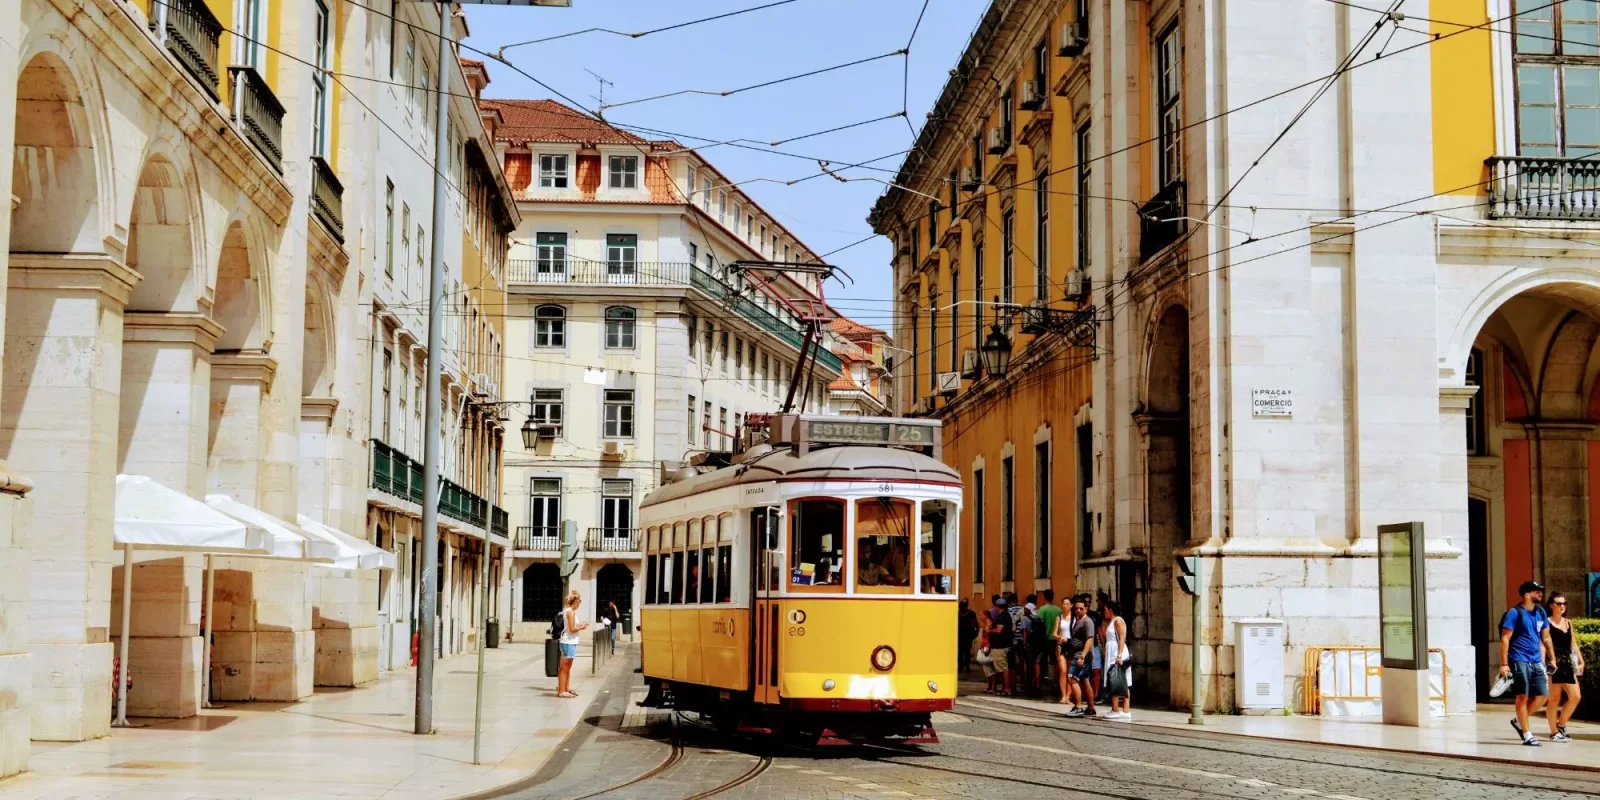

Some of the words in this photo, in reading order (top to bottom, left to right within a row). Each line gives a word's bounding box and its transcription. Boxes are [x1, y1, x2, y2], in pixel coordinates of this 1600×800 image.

[1254, 399, 1292, 407] COMERCIO
[813, 423, 882, 437] ESTRELA
[897, 426, 922, 441] 25
[878, 484, 894, 493] 581
